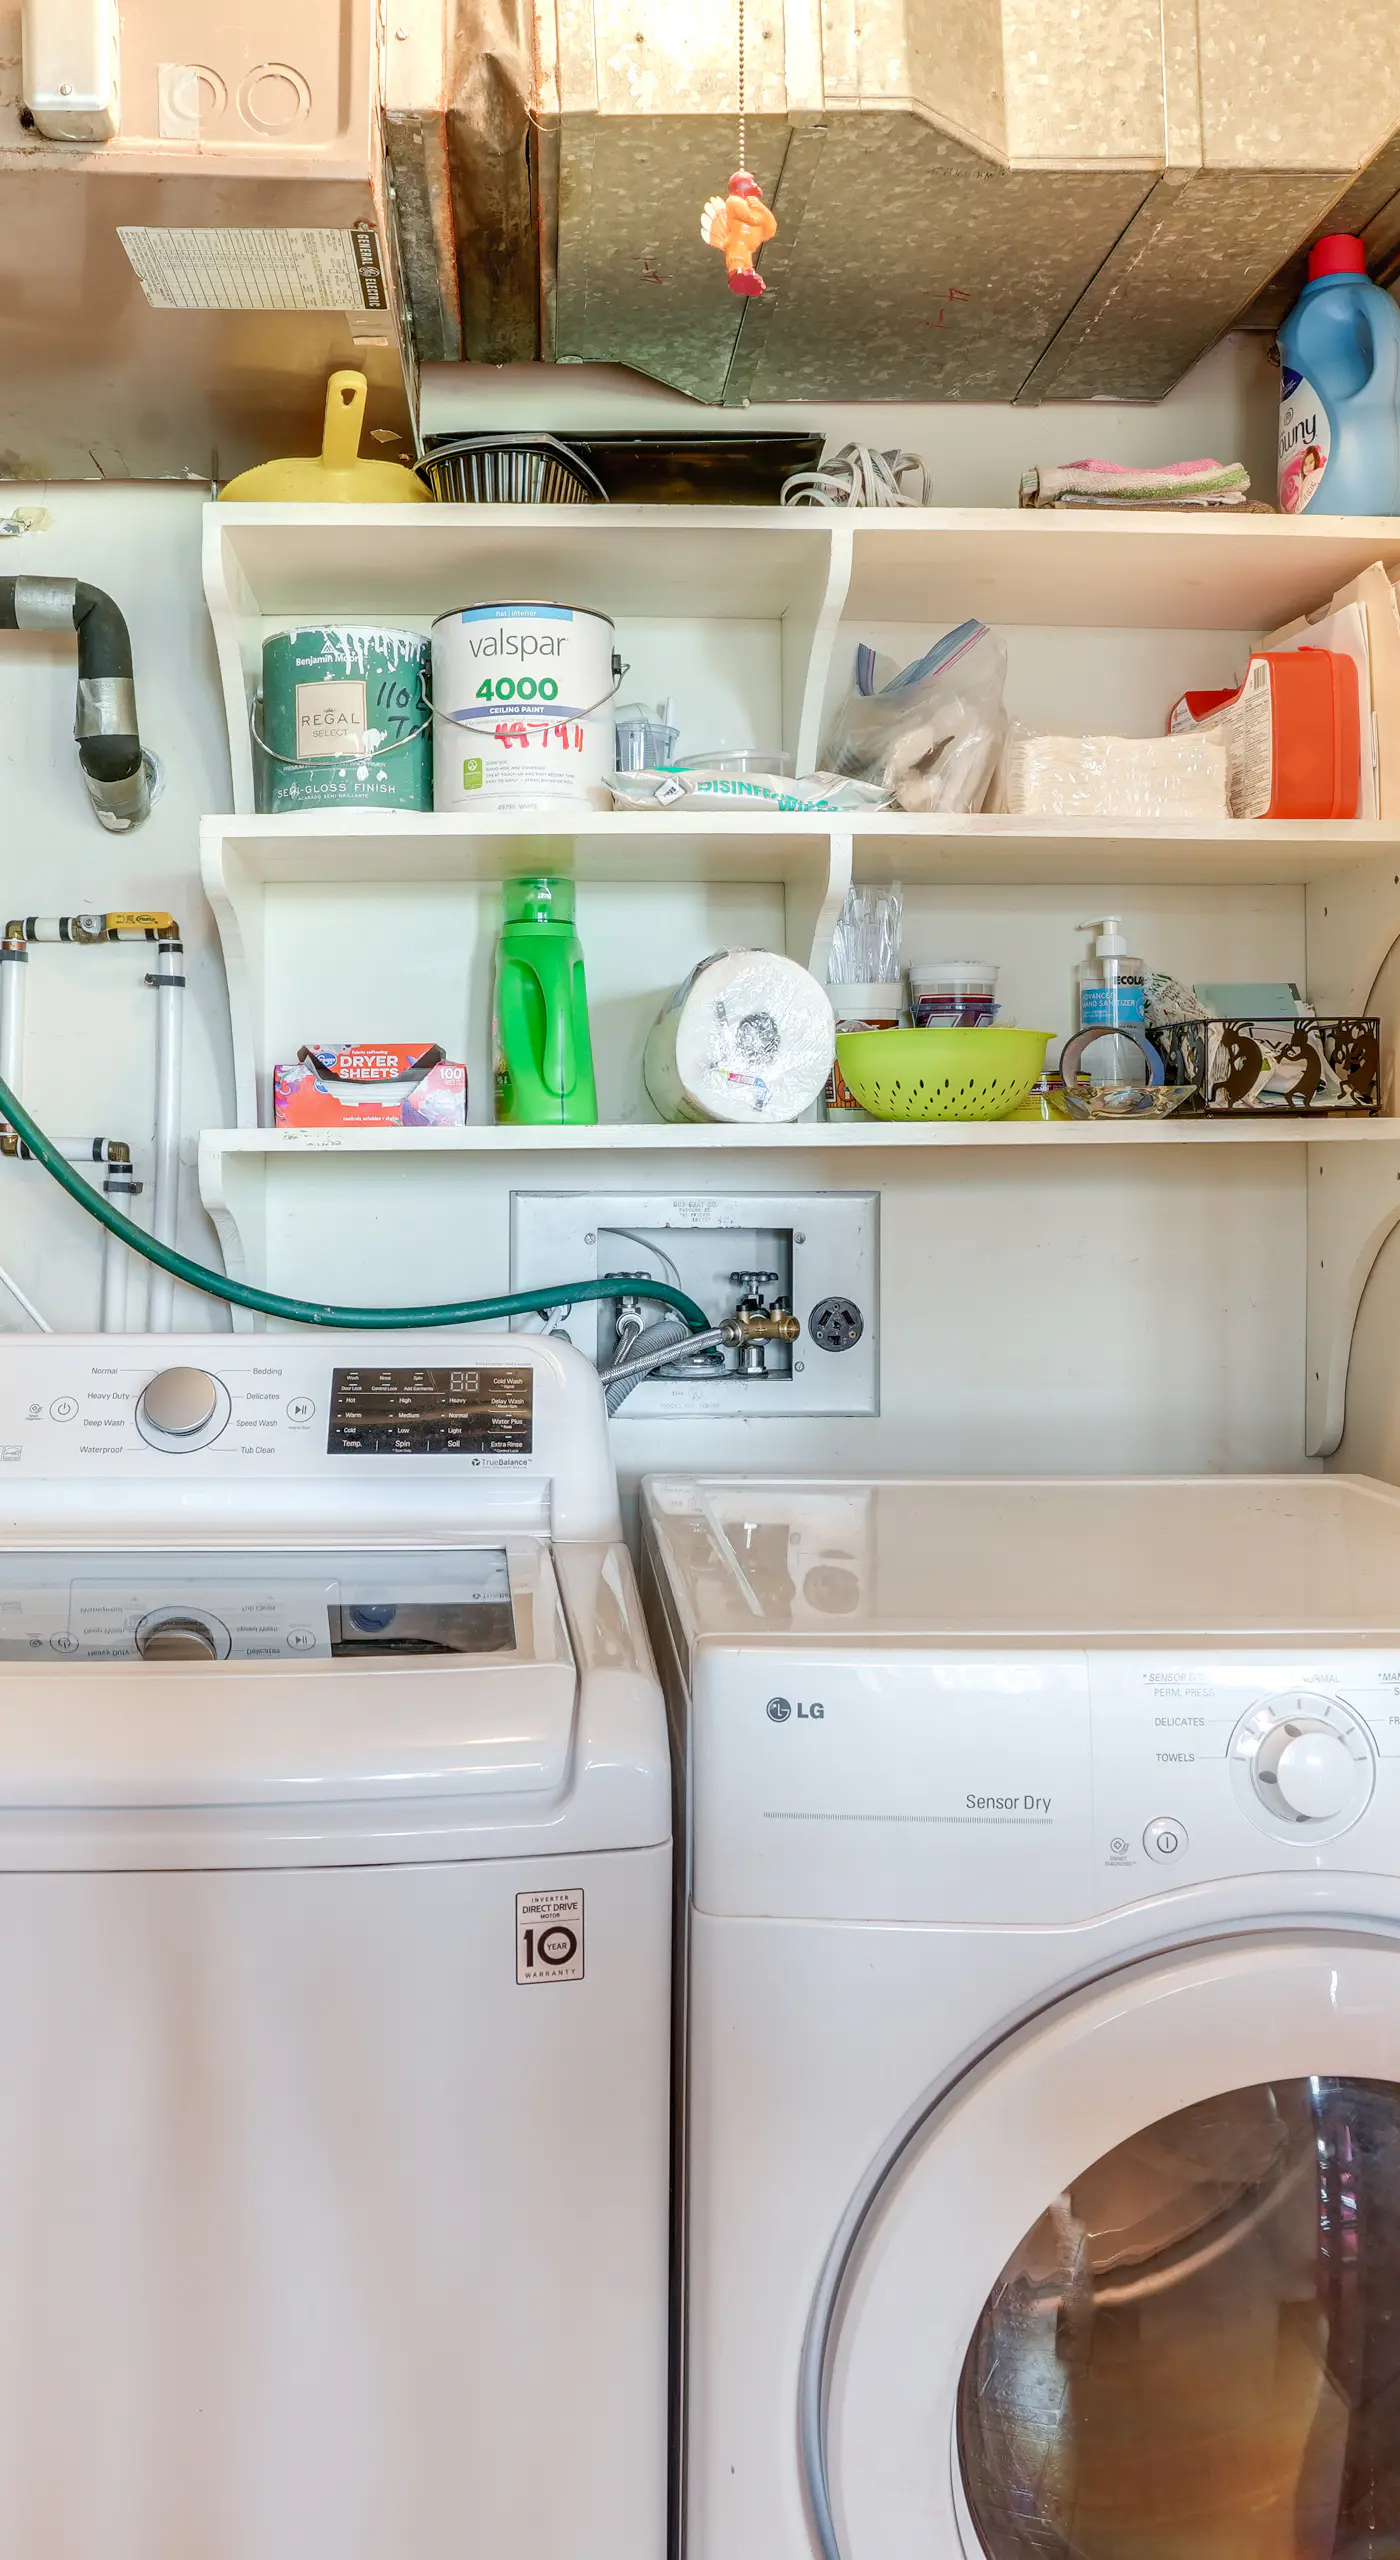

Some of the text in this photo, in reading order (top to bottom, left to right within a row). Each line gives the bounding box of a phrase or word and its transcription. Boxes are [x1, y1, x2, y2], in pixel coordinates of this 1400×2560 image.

[356, 233, 380, 308] GENERAL ELECTRIC
[1279, 413, 1317, 459] owny
[469, 628, 565, 662] valspar
[296, 654, 362, 666] Benjamin Moor
[476, 677, 558, 702] 4000
[302, 713, 360, 727] REGAL
[312, 729, 348, 738] SELECT
[355, 784, 395, 793] FINISH
[340, 1056, 398, 1067] DRYER
[340, 1068, 399, 1079] SHEETS
[440, 1068, 462, 1079] 100
[91, 1367, 118, 1375] Normal
[253, 1368, 282, 1376] Bedding
[87, 1392, 130, 1401] Heavy Duty
[83, 1419, 125, 1428] Deep Wash
[236, 1419, 278, 1428] Speed Wash
[80, 1446, 123, 1455] Waterproof
[1149, 1673, 1187, 1682] SENSOR
[1154, 1688, 1215, 1697] PERM. PRESS
[797, 1702, 825, 1719] LG
[1155, 1717, 1205, 1727] DELICATES
[1156, 1753, 1195, 1762] TOWELS
[966, 1794, 1051, 1813] Sensor Dry
[532, 1895, 569, 1903] INVERTER
[522, 1902, 578, 1914] DIRECT DRIVE
[524, 1926, 577, 1967] 10
[547, 1943, 568, 1951] YEAR
[525, 1969, 576, 1978] WARRANTY
